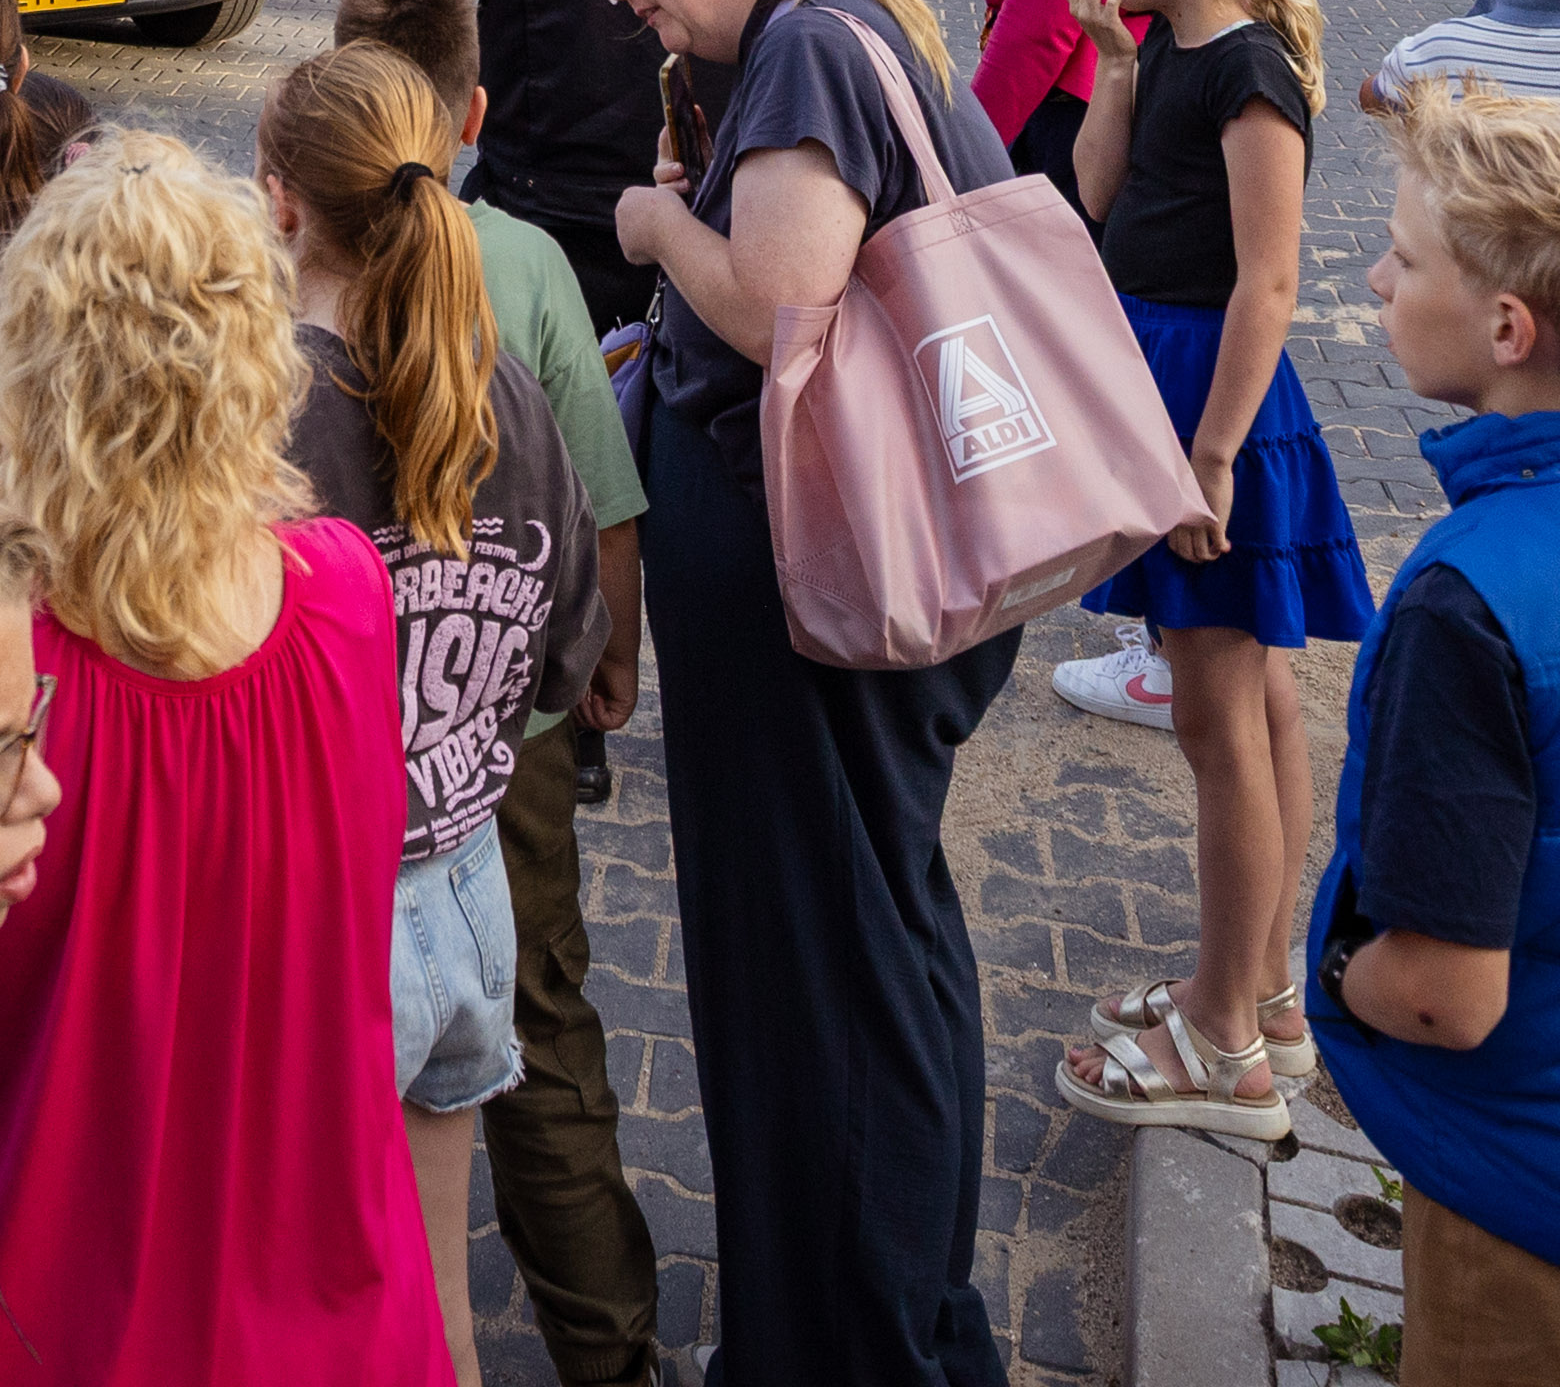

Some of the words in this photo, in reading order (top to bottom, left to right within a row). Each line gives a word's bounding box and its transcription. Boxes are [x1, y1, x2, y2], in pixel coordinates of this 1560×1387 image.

[963, 416, 1031, 463] ALDI
[474, 541, 517, 563] FESTIVAL
[394, 558, 544, 625] RBEACH
[405, 706, 498, 808] VIBES
